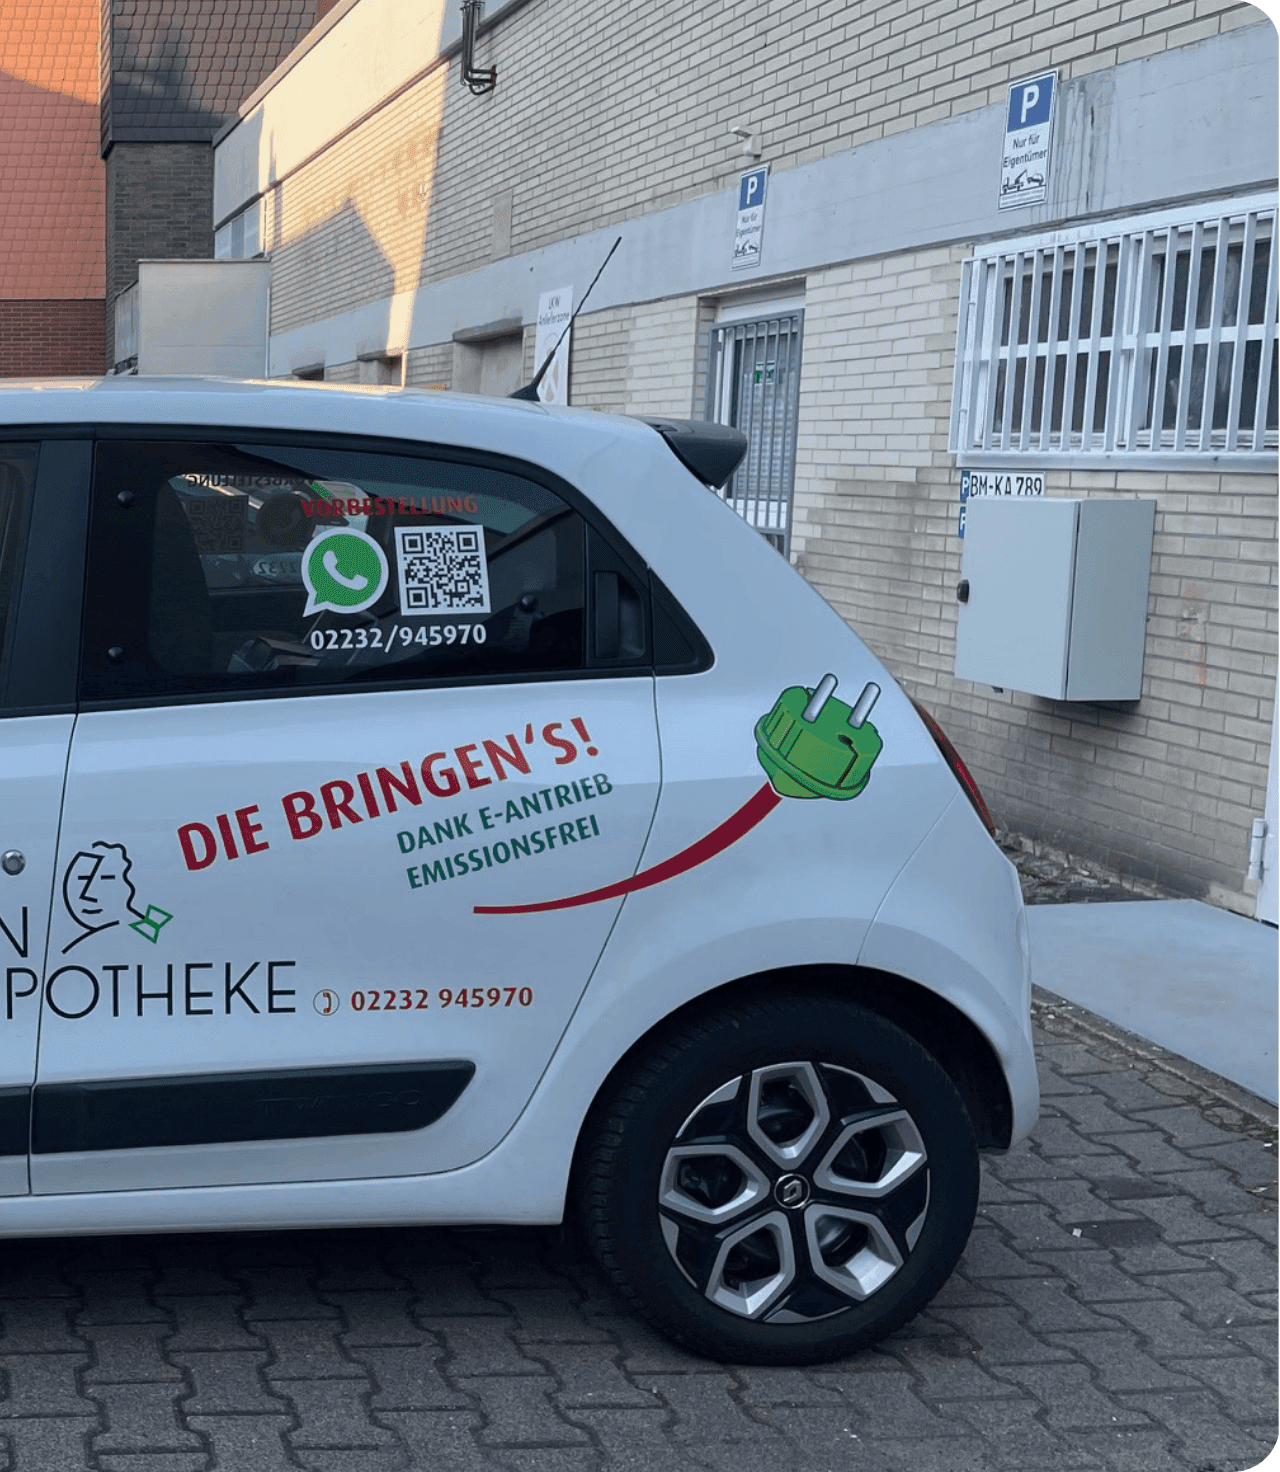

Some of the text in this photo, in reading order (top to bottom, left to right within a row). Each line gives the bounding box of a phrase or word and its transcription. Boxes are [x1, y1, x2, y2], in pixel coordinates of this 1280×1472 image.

[1021, 85, 1039, 123] P
[1013, 134, 1040, 149] Nur für
[1003, 150, 1047, 168] Eigentümer
[747, 176, 758, 204] P
[970, 475, 1012, 497] BM-KA
[1016, 476, 1042, 496] 789
[300, 495, 478, 518] VORBESTELLUNG
[310, 624, 487, 653] 02232/945970
[176, 716, 600, 872] DIE BRINGEN'S!
[396, 772, 614, 854] DANK E-ANTRIEB
[406, 813, 601, 889] EMISSIONSFREI
[351, 986, 534, 1012] 02232 945970
